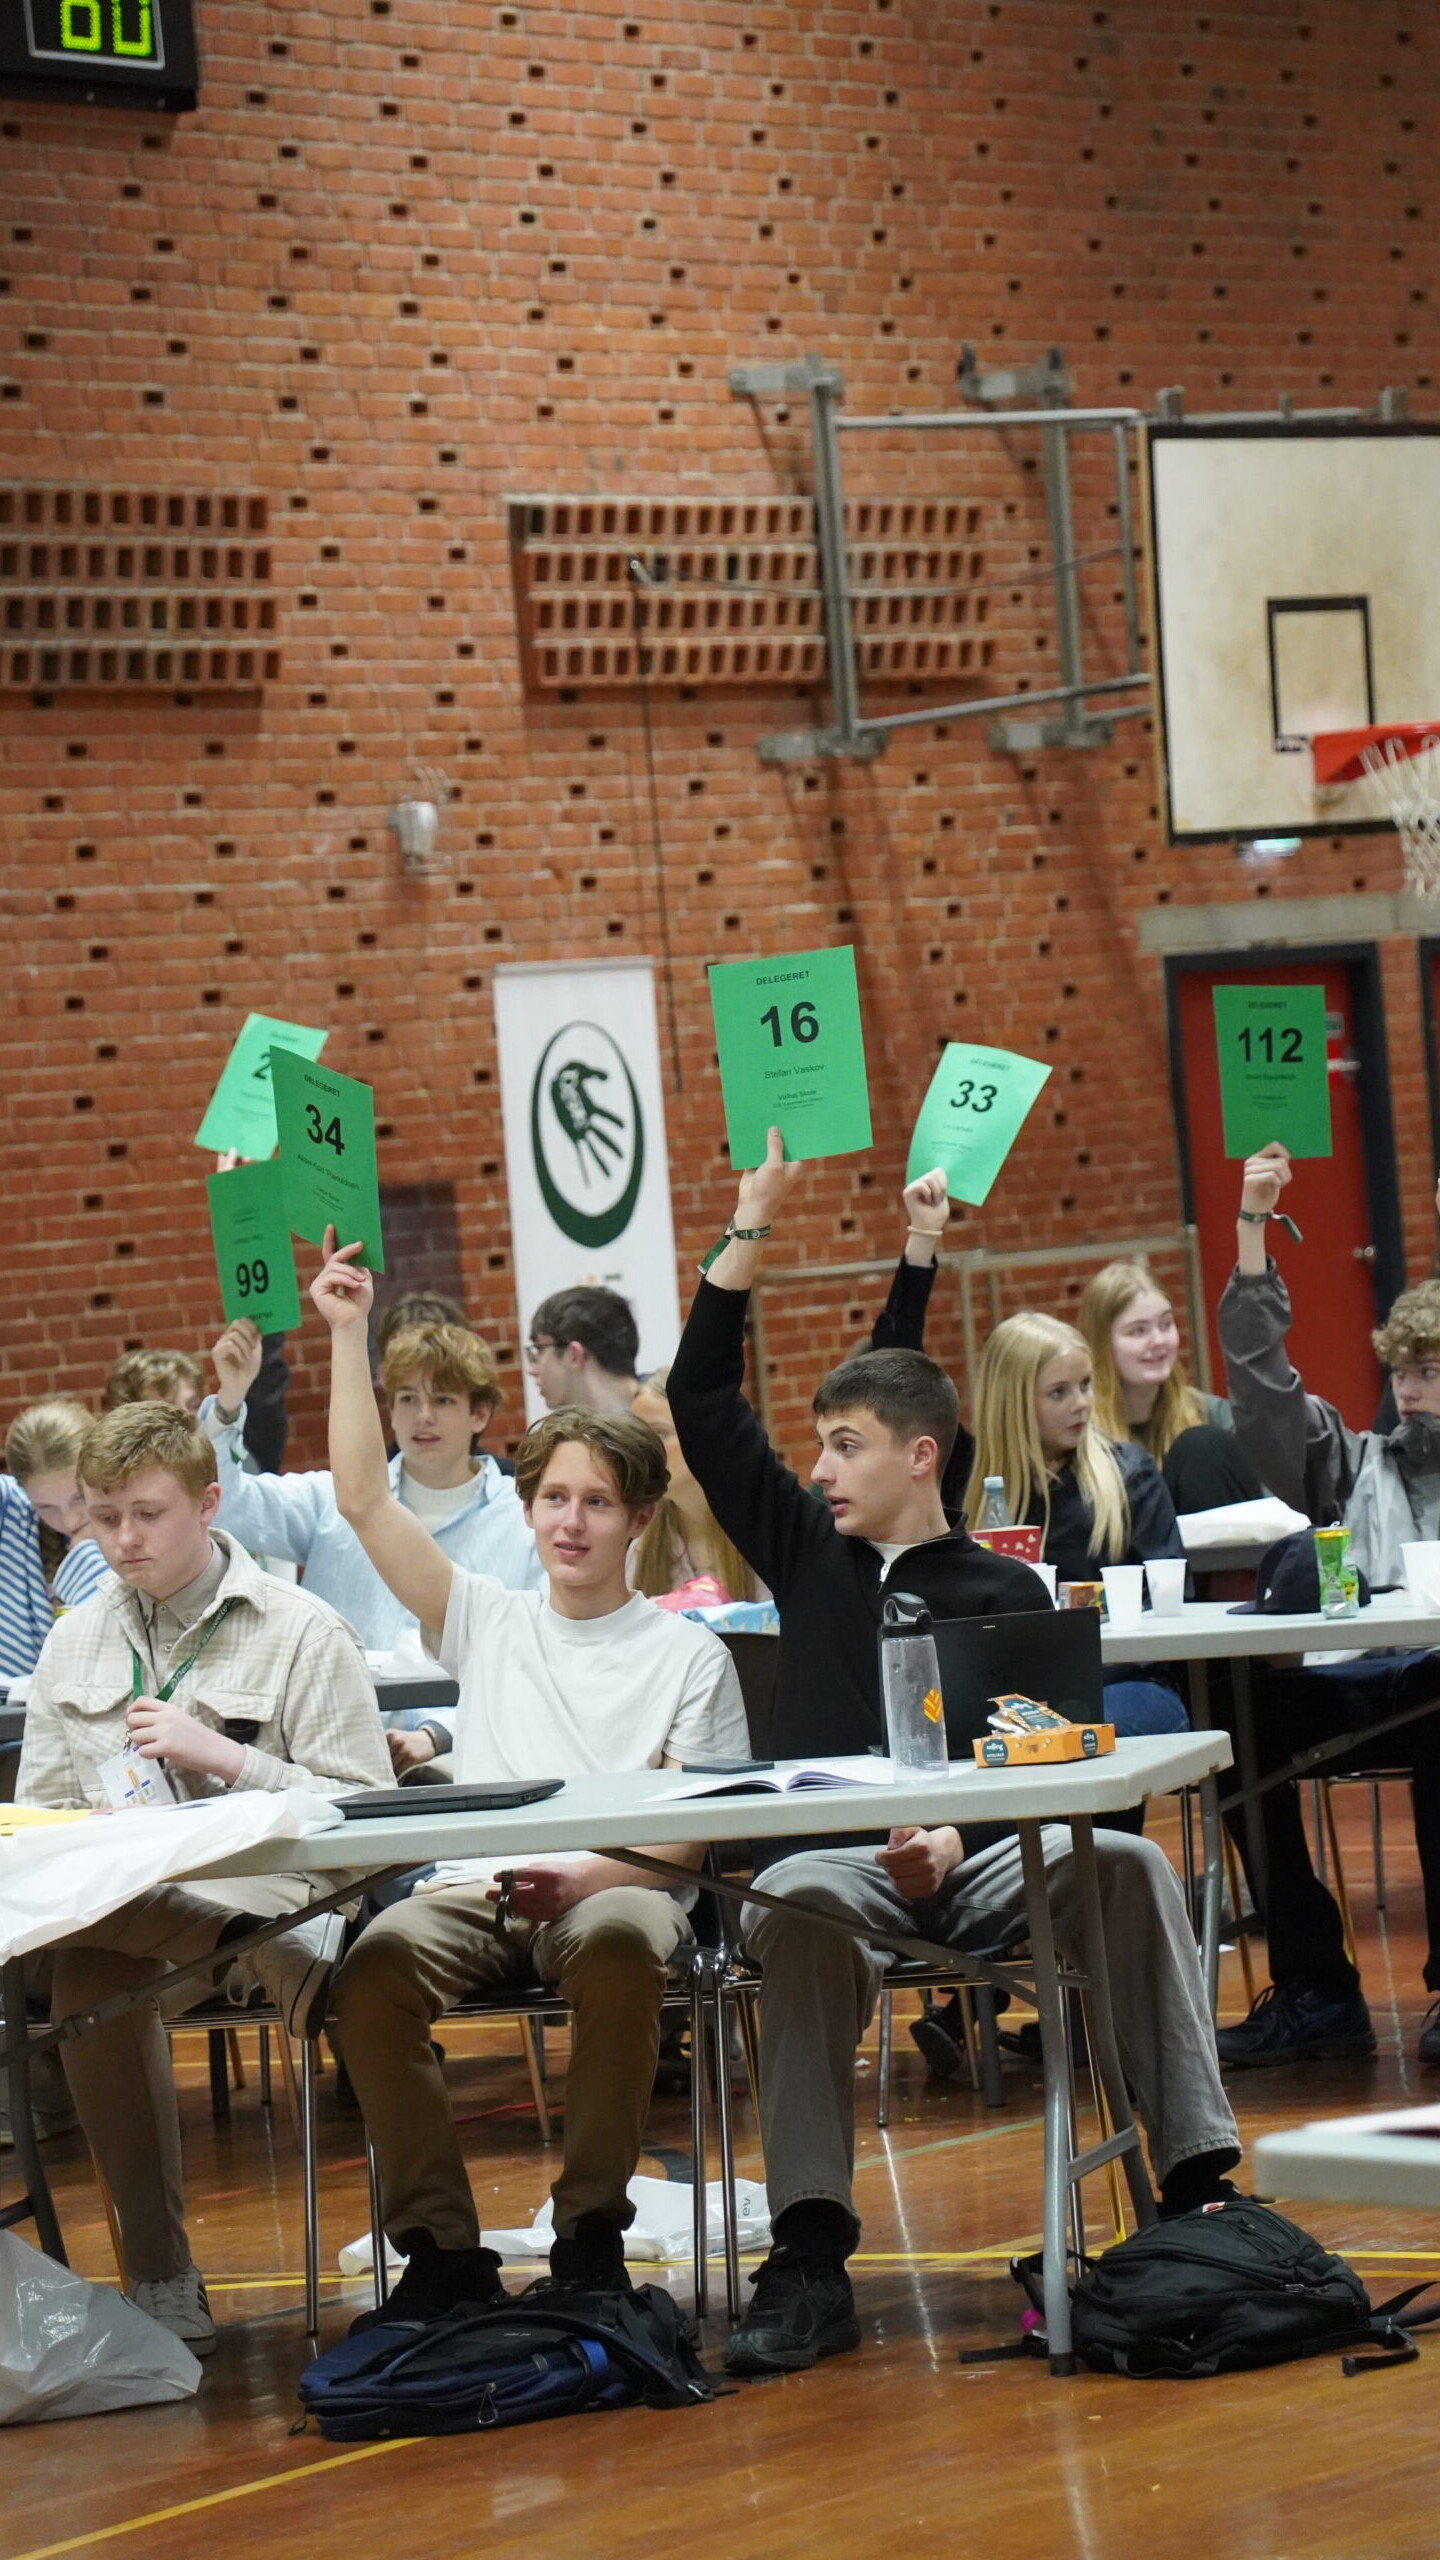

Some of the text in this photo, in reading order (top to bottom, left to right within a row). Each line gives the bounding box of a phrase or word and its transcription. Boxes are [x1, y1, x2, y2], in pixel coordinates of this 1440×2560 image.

[756, 970, 810, 985] DELEGERET
[760, 1001, 820, 1048] 16
[1238, 1026, 1304, 1063] 112
[304, 1073, 341, 1098] DELEGERET
[764, 1064, 825, 1079] Stefan Vaskov
[950, 1080, 998, 1113] 33
[305, 1104, 346, 1156] 34
